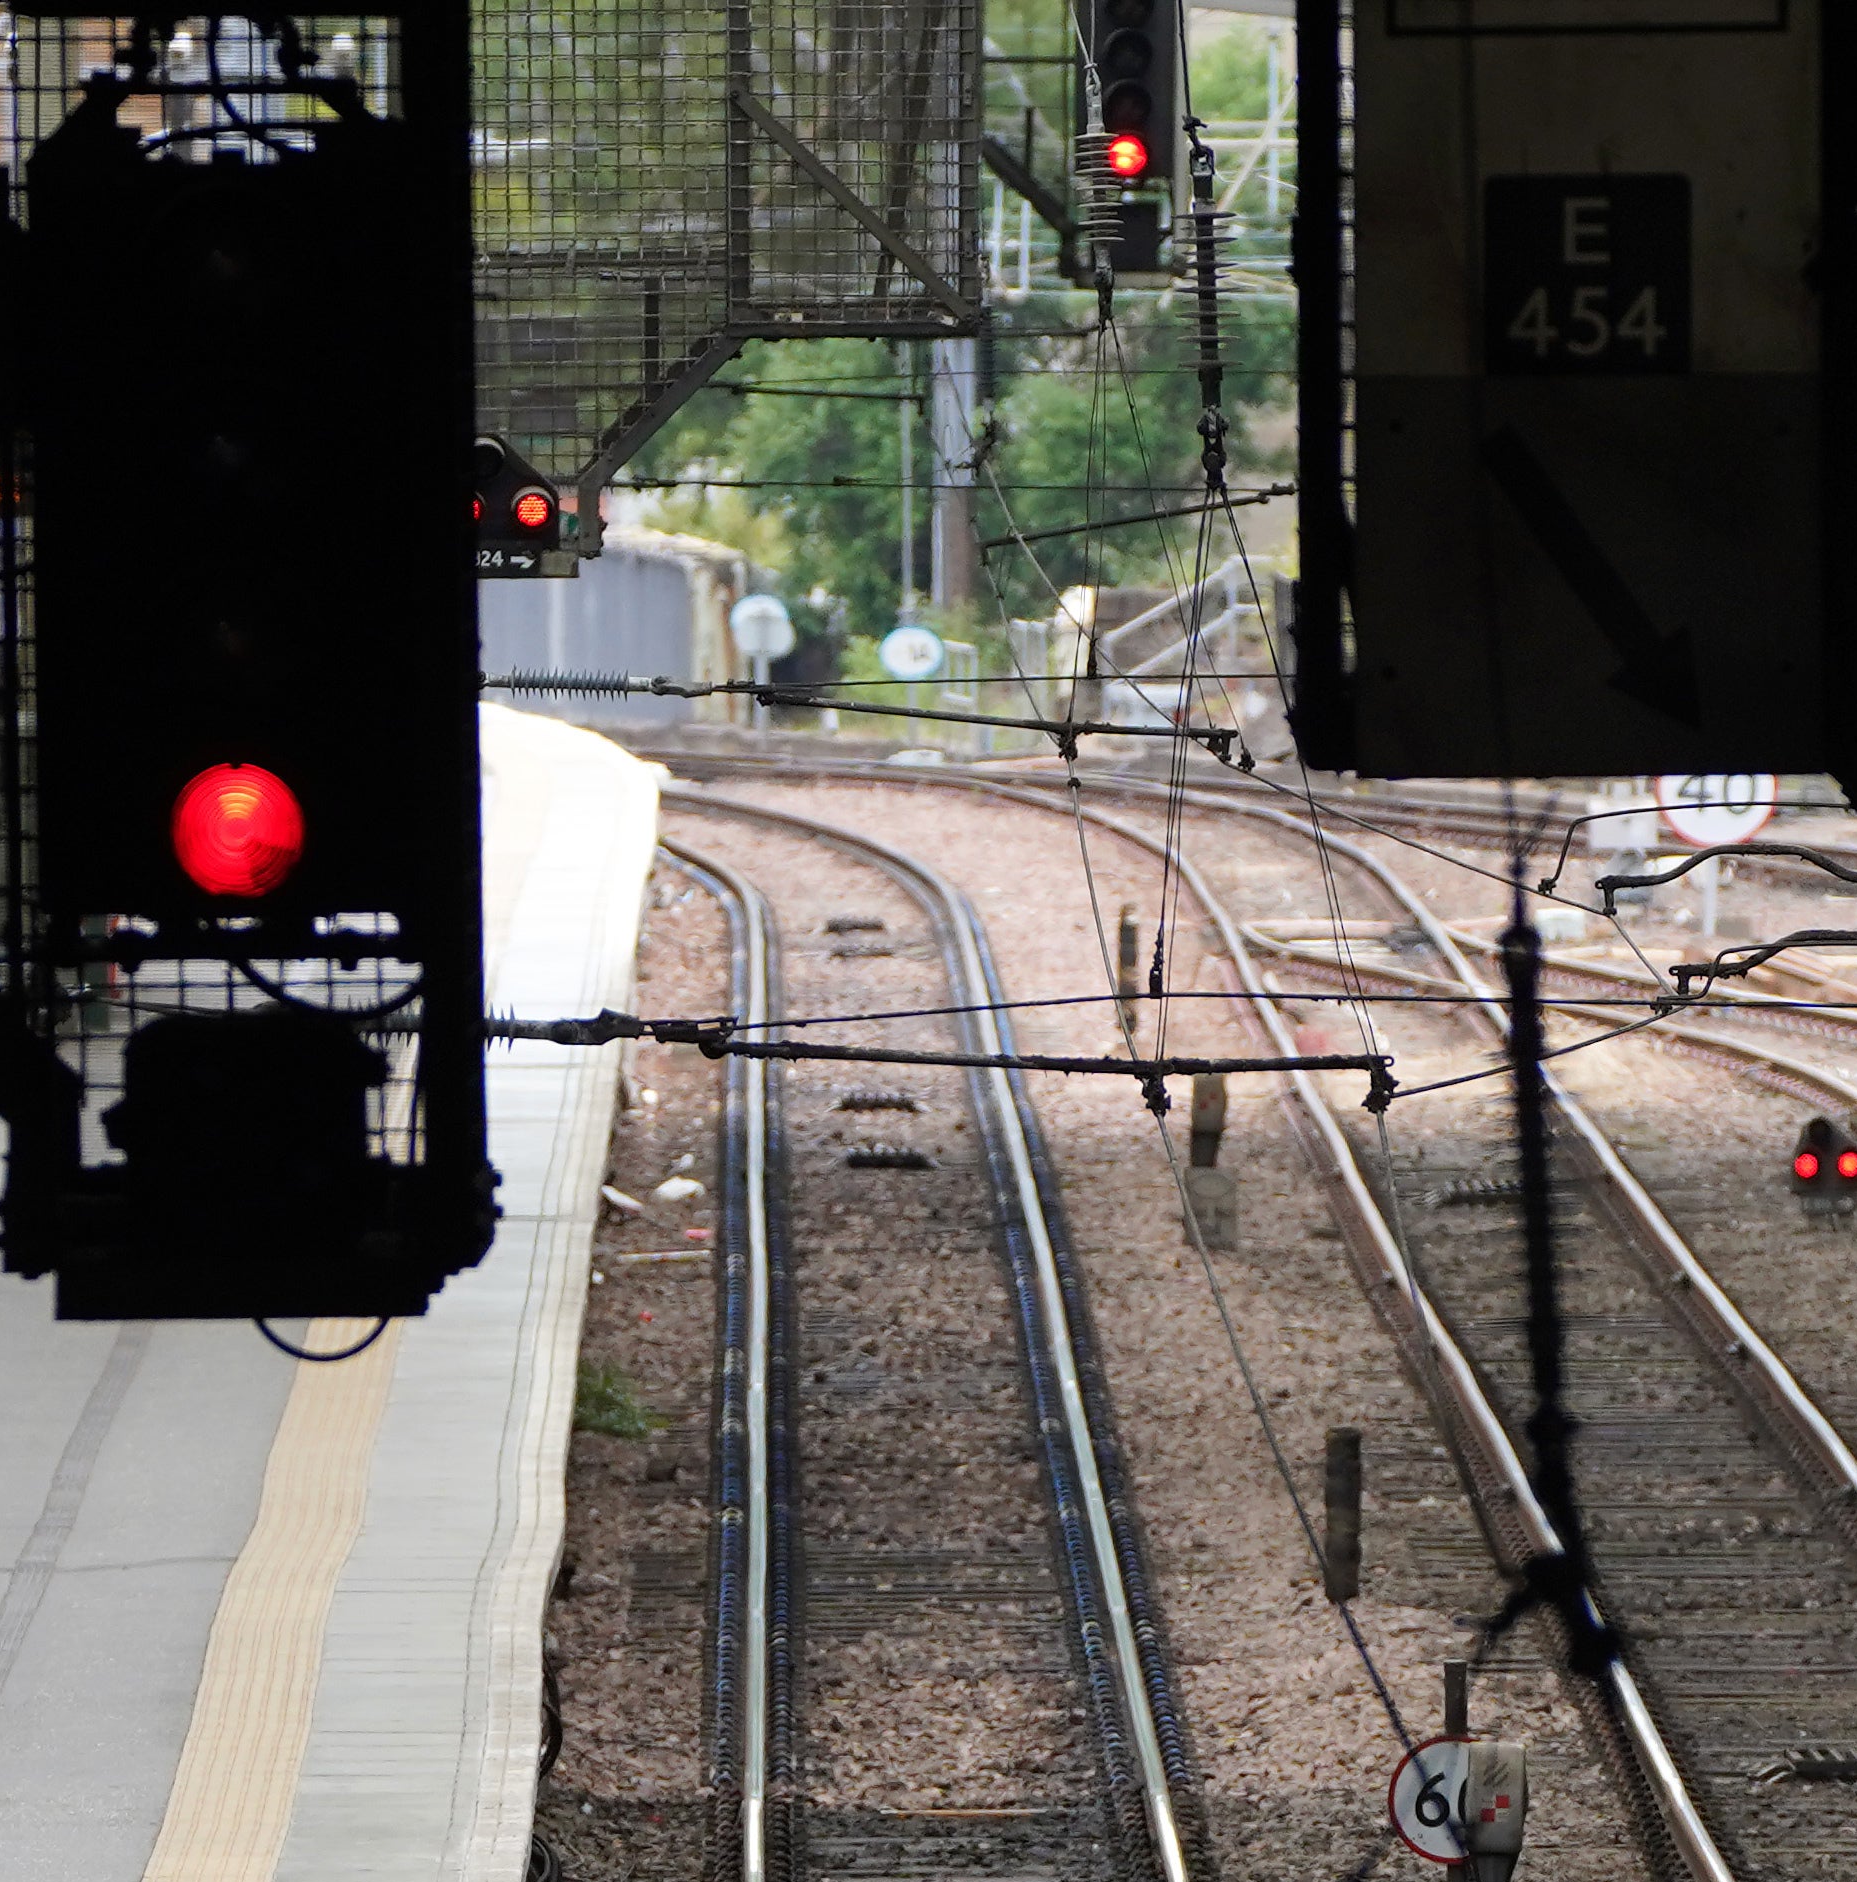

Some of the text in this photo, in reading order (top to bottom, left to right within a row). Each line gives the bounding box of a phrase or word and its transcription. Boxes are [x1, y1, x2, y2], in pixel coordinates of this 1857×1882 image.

[1563, 197, 1611, 265] E
[1507, 287, 1668, 356] 454
[1677, 775, 1755, 815] 40
